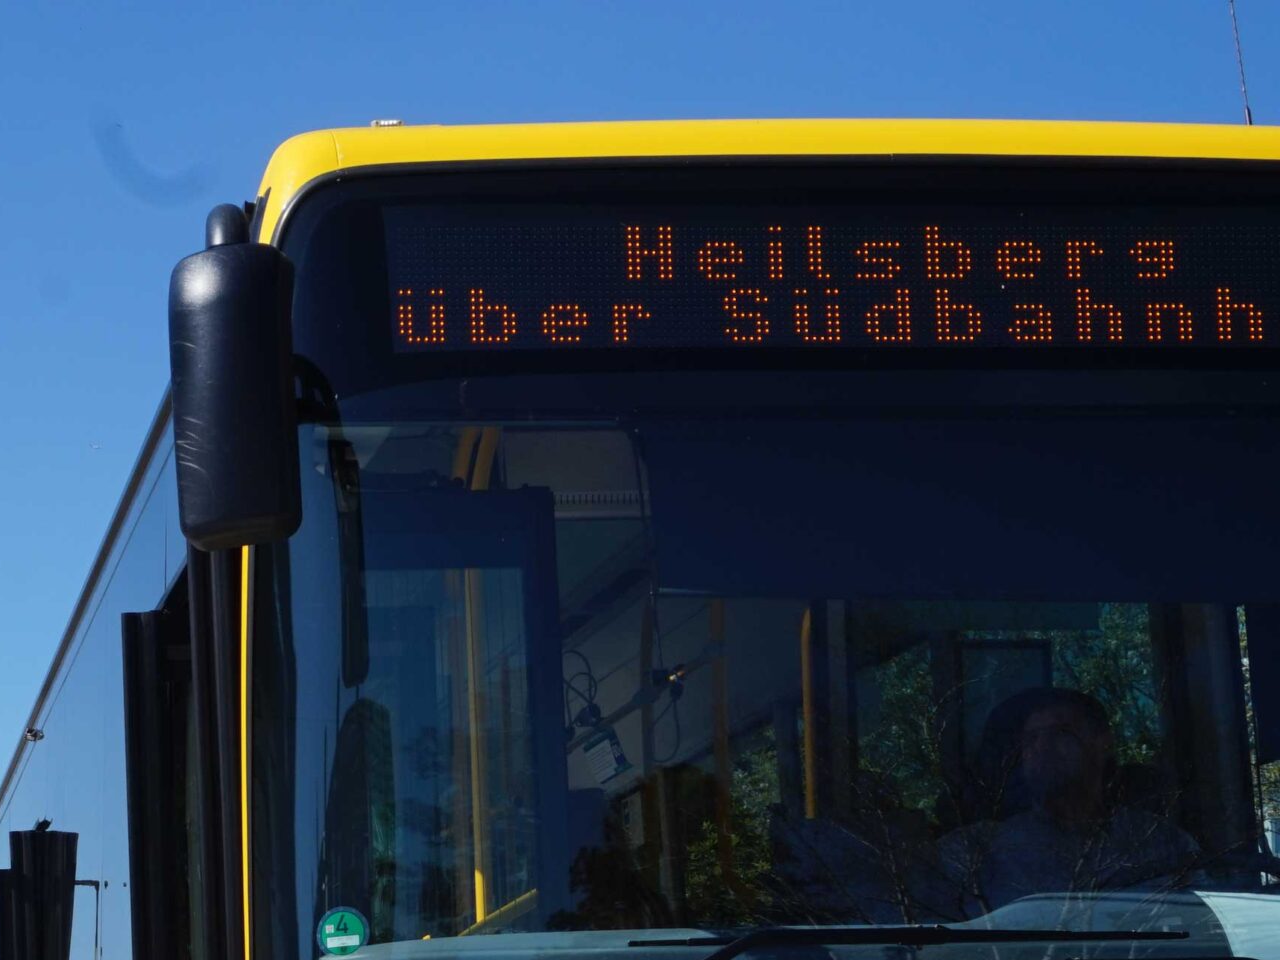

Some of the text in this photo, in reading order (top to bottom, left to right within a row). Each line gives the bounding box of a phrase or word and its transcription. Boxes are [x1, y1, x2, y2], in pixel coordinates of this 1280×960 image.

[625, 224, 1177, 281] Heilsberg
[395, 286, 1265, 344] über Südbahnh
[336, 914, 348, 934] 4
